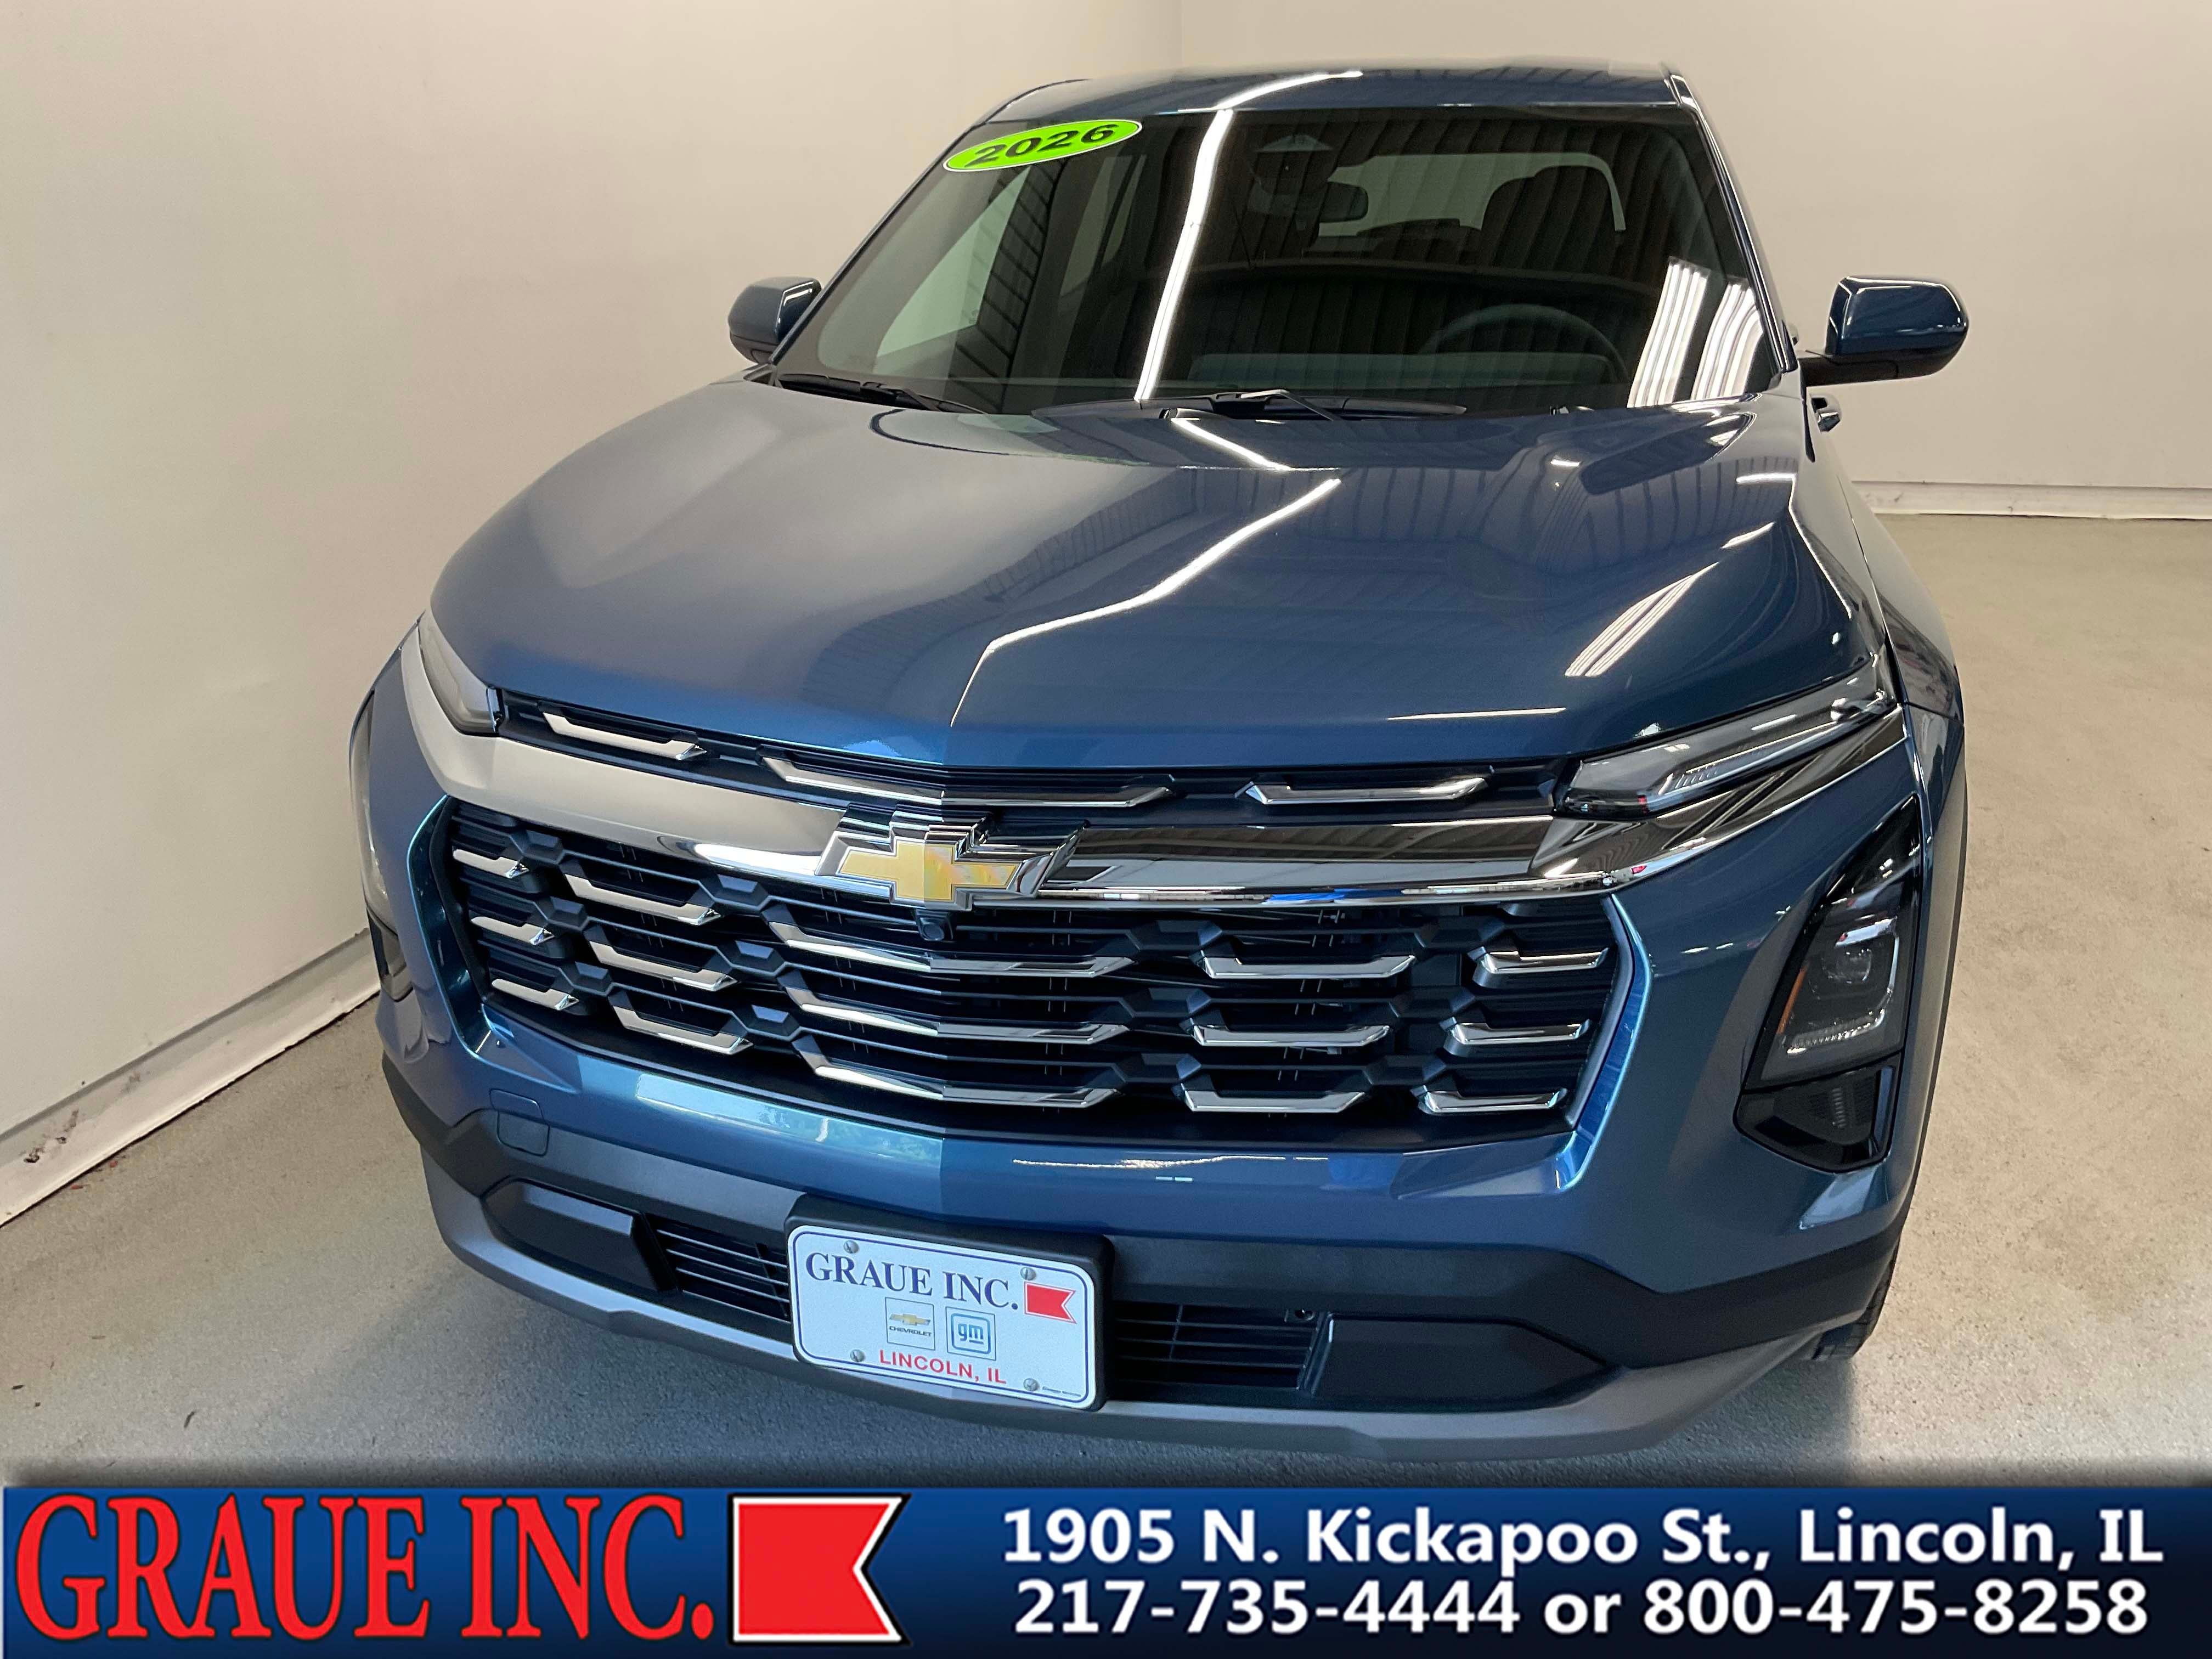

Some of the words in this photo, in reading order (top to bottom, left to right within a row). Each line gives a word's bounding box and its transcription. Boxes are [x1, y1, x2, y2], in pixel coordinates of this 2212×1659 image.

[965, 124, 1119, 167] 2026
[805, 1252, 933, 1296] GRAUE
[943, 1271, 1019, 1311] INC.
[889, 1325, 932, 1338] CHEVROLET
[958, 1323, 984, 1345] gm
[879, 1350, 980, 1383] LINCOLN,
[988, 1367, 1007, 1384] IL
